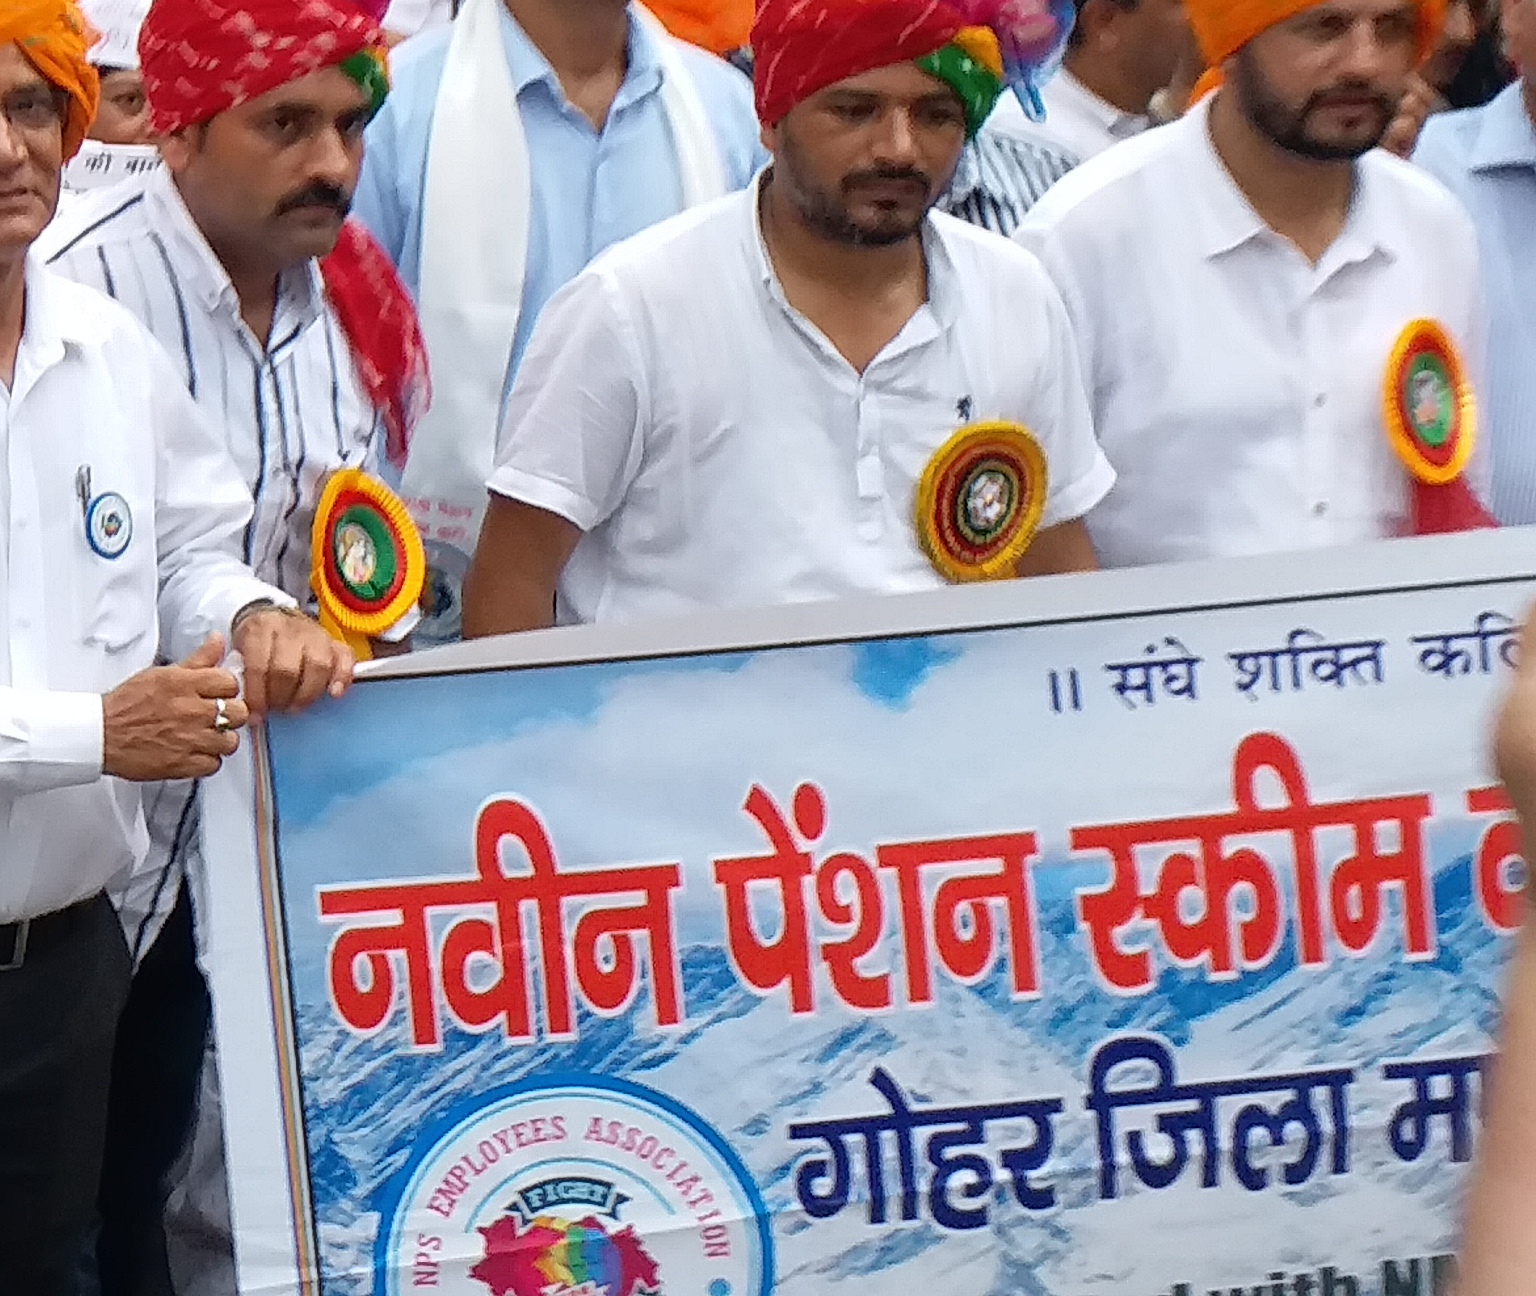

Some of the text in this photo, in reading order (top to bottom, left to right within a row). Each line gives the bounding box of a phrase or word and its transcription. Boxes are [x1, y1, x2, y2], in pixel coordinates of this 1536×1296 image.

[1104, 636, 1202, 708] संघे
[1228, 628, 1387, 702] शक्ति
[318, 796, 682, 1046] नवीन
[712, 782, 1040, 1016] पेंशन
[1069, 730, 1435, 992] स्कीम
[413, 1114, 732, 1288] NPS EMPLOYEES ASSOCIATION
[788, 1067, 1064, 1229] गोहर
[1085, 1034, 1355, 1202] जिला
